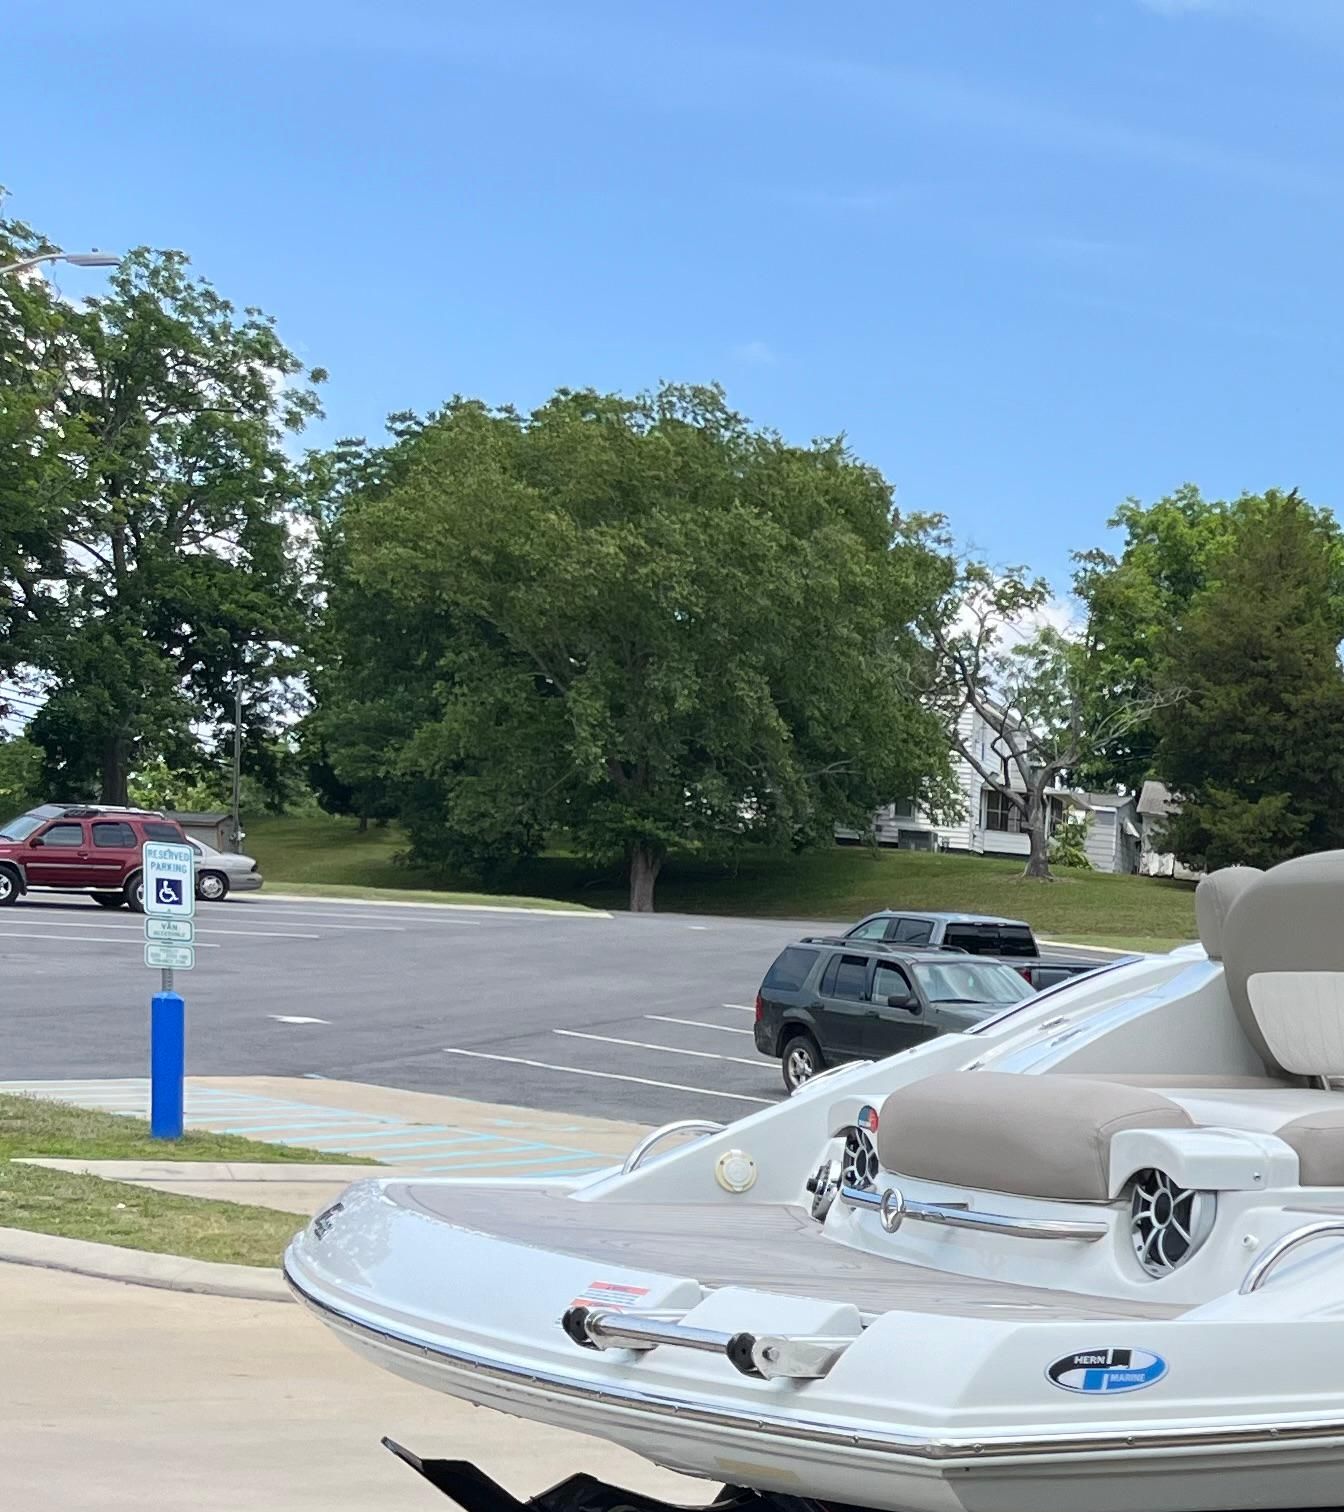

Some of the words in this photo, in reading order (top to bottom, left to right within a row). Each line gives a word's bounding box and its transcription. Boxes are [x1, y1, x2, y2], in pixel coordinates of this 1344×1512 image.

[148, 849, 190, 861] RESERVED
[151, 861, 187, 874] PARKING
[1073, 1355, 1106, 1365] HERN
[1110, 1373, 1146, 1383] MARINE
